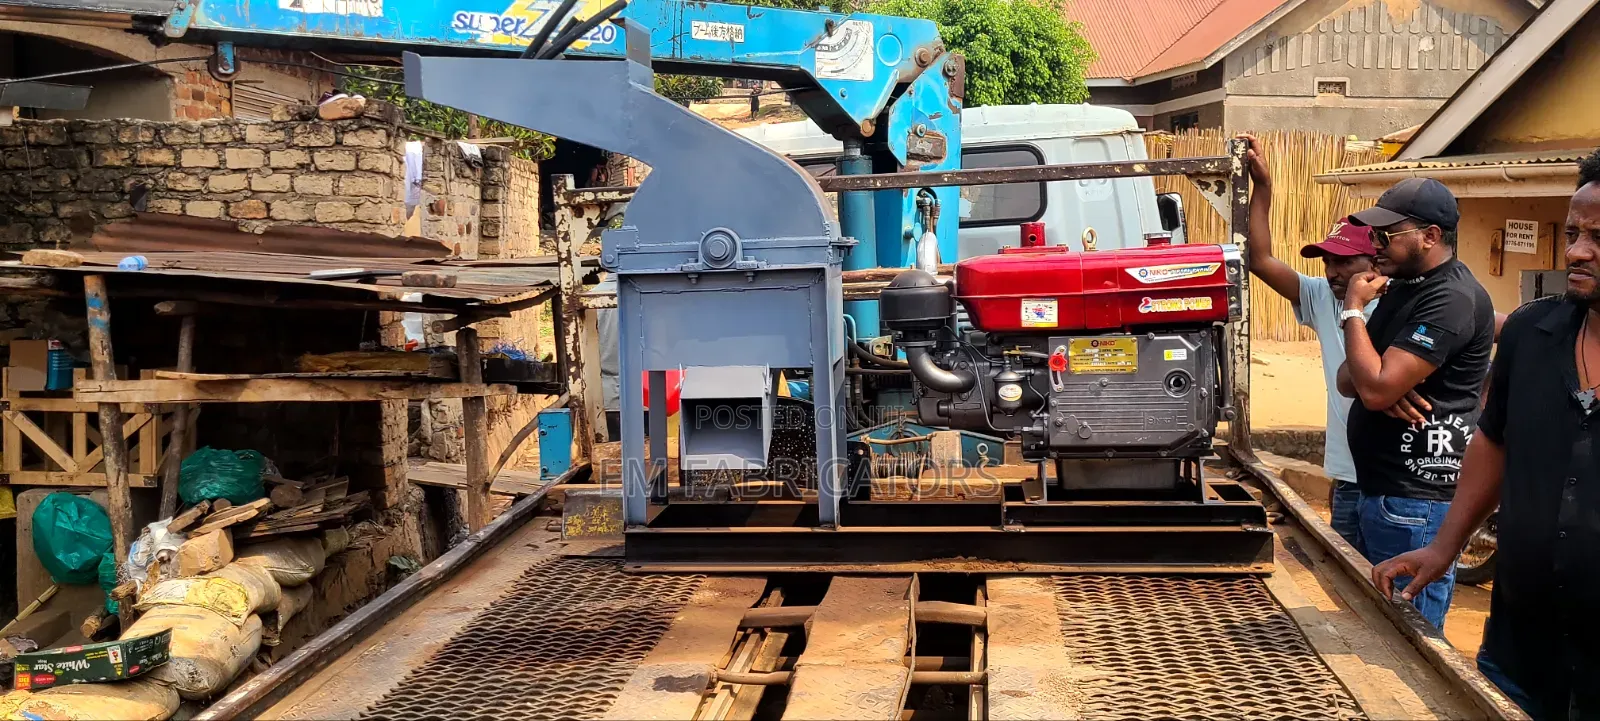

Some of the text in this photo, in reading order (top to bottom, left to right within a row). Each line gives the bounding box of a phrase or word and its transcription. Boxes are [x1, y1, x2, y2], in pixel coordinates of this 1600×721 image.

[580, 24, 615, 42] 20
[1508, 221, 1534, 231] HOUSE
[1151, 298, 1184, 312] STRONG
[1400, 414, 1473, 453] ROYAL JEAN
[1404, 458, 1438, 481] JEANS
[33, 662, 55, 673] Star
[56, 658, 91, 672] White
